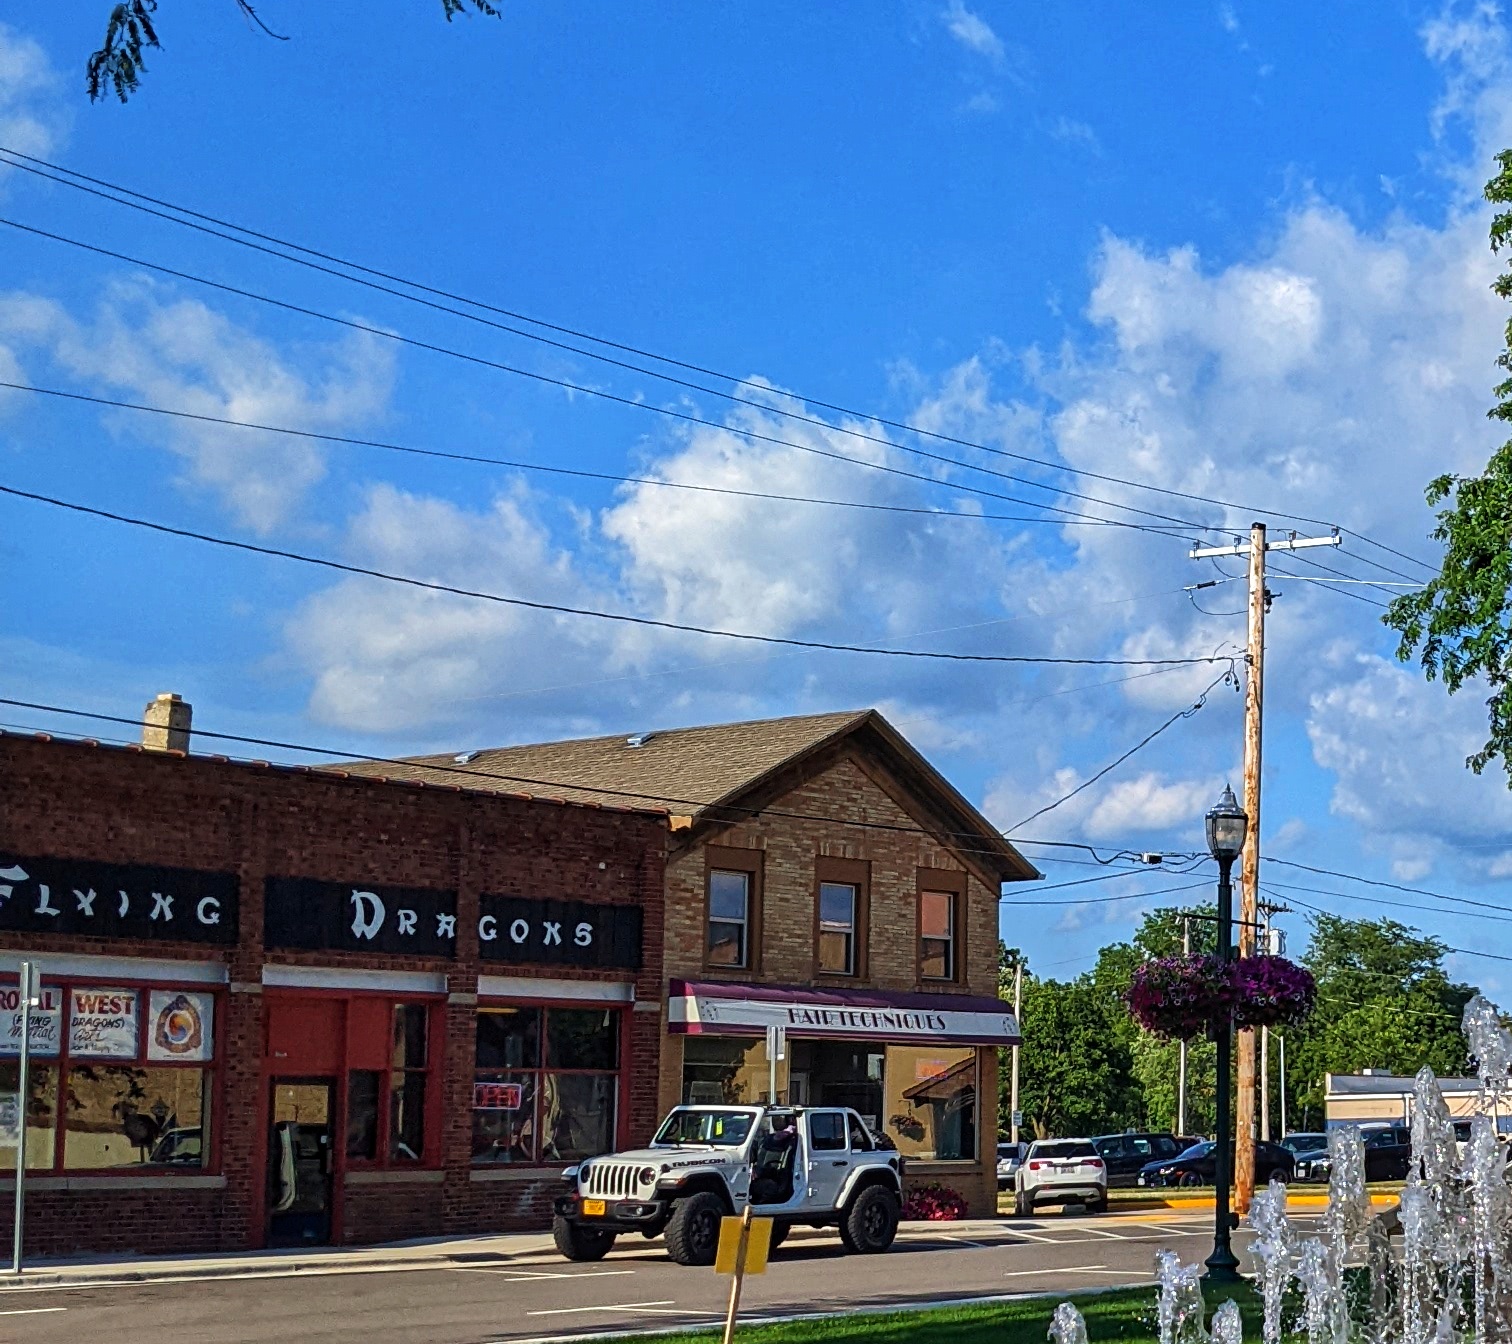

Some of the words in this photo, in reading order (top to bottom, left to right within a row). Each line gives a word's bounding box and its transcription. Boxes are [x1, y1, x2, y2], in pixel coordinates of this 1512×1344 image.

[350, 889, 593, 946] DRAGONS
[0, 990, 56, 1010] ROL
[75, 994, 134, 1014] WEST
[787, 1008, 833, 1025] HAIR
[839, 1010, 946, 1030] TECHNIQUES
[672, 1158, 726, 1167] RUBICON
